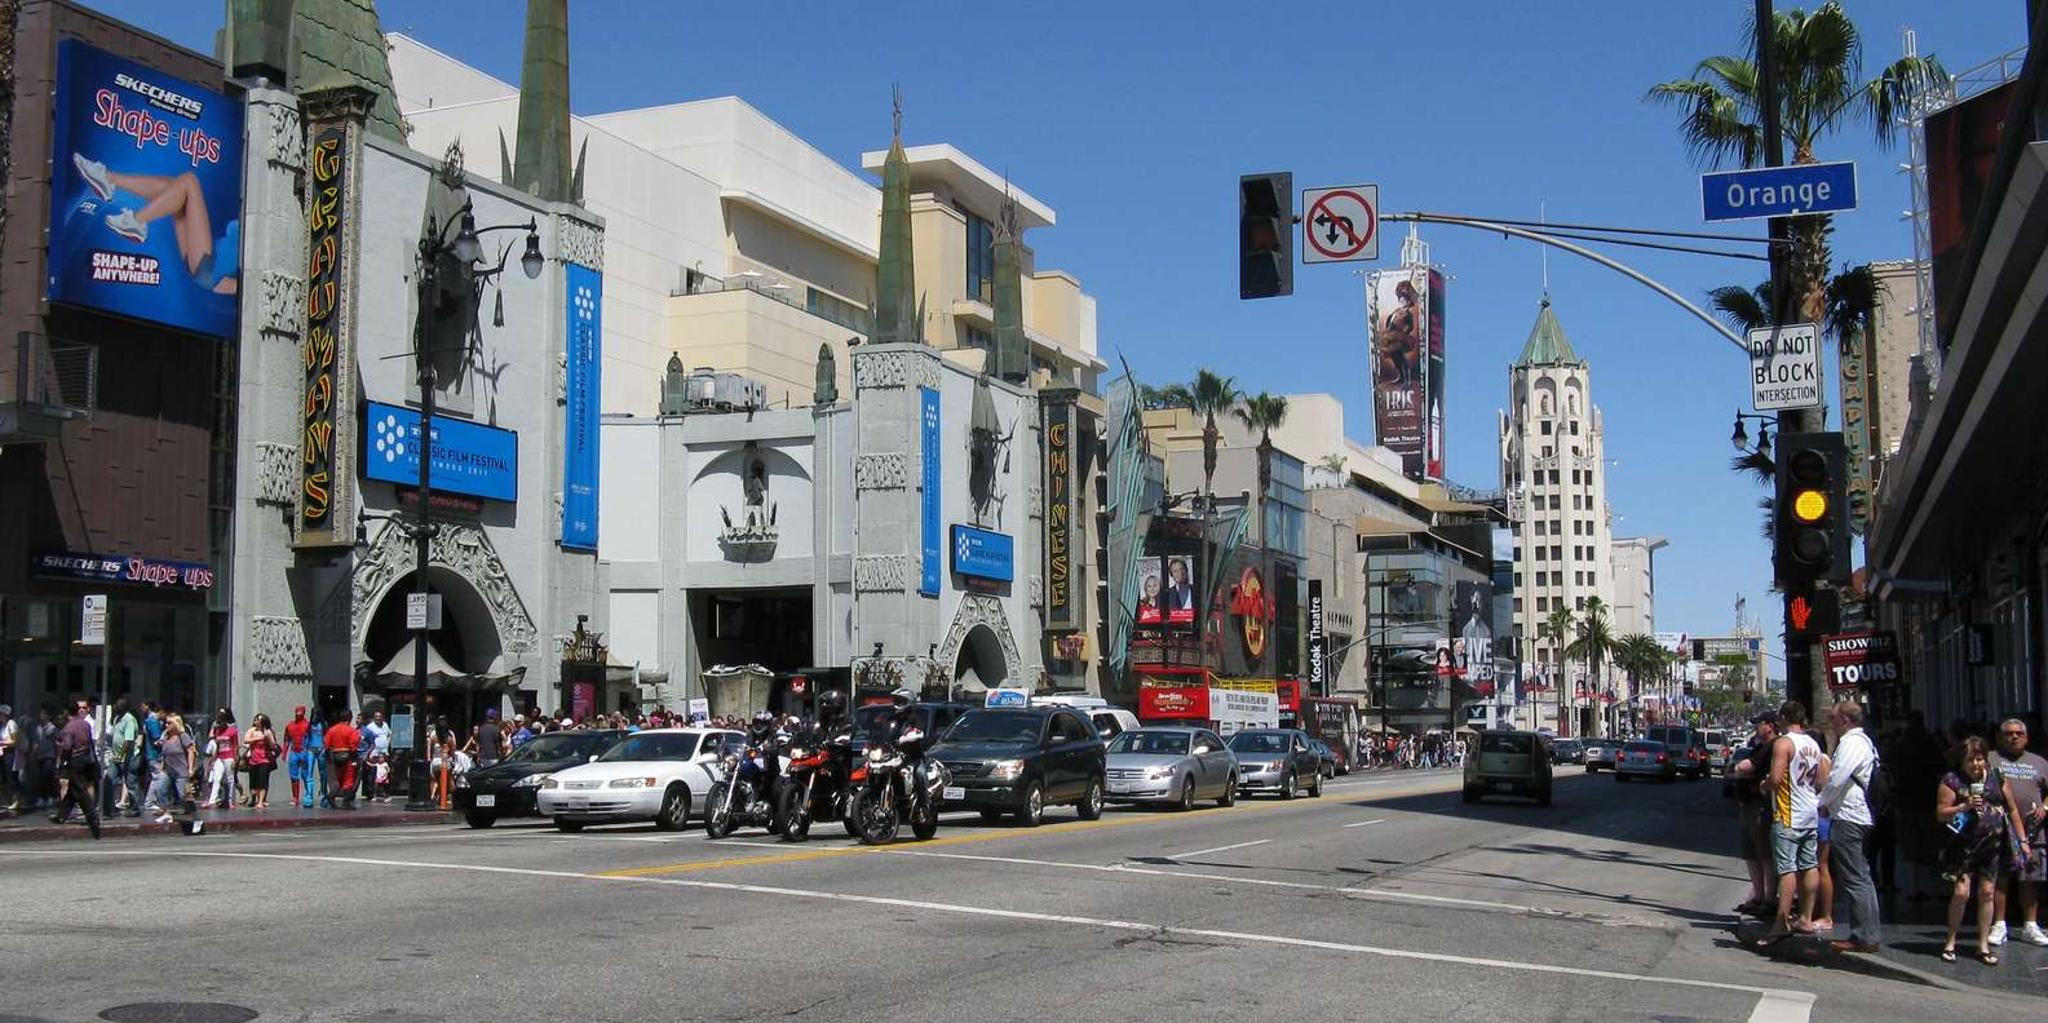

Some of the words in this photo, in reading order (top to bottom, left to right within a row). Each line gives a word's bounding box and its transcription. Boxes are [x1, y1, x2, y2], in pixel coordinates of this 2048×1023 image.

[114, 73, 205, 113] SKECHERS
[1727, 181, 1831, 209] Orange
[92, 253, 159, 272] SHAPE-UP
[92, 267, 160, 285] ANYWHERE!
[1753, 339, 1775, 358] DO
[1783, 336, 1813, 355] NOT
[1755, 362, 1815, 385] BLOCK
[1386, 389, 1415, 411] IRIS
[1756, 386, 1816, 403] INTERSECTION
[407, 441, 446, 460] CLSIC
[448, 448, 468, 463] FILM
[471, 453, 510, 473] FESTIVAL
[408, 456, 463, 473] HOYWOOD
[1050, 423, 1068, 607] CHINESE
[1309, 596, 1321, 641] Theatre
[1468, 638, 1493, 663] IVE
[1310, 644, 1322, 683] Kodak
[1832, 661, 1897, 684] TOURS
[1796, 763, 1819, 786] 24
